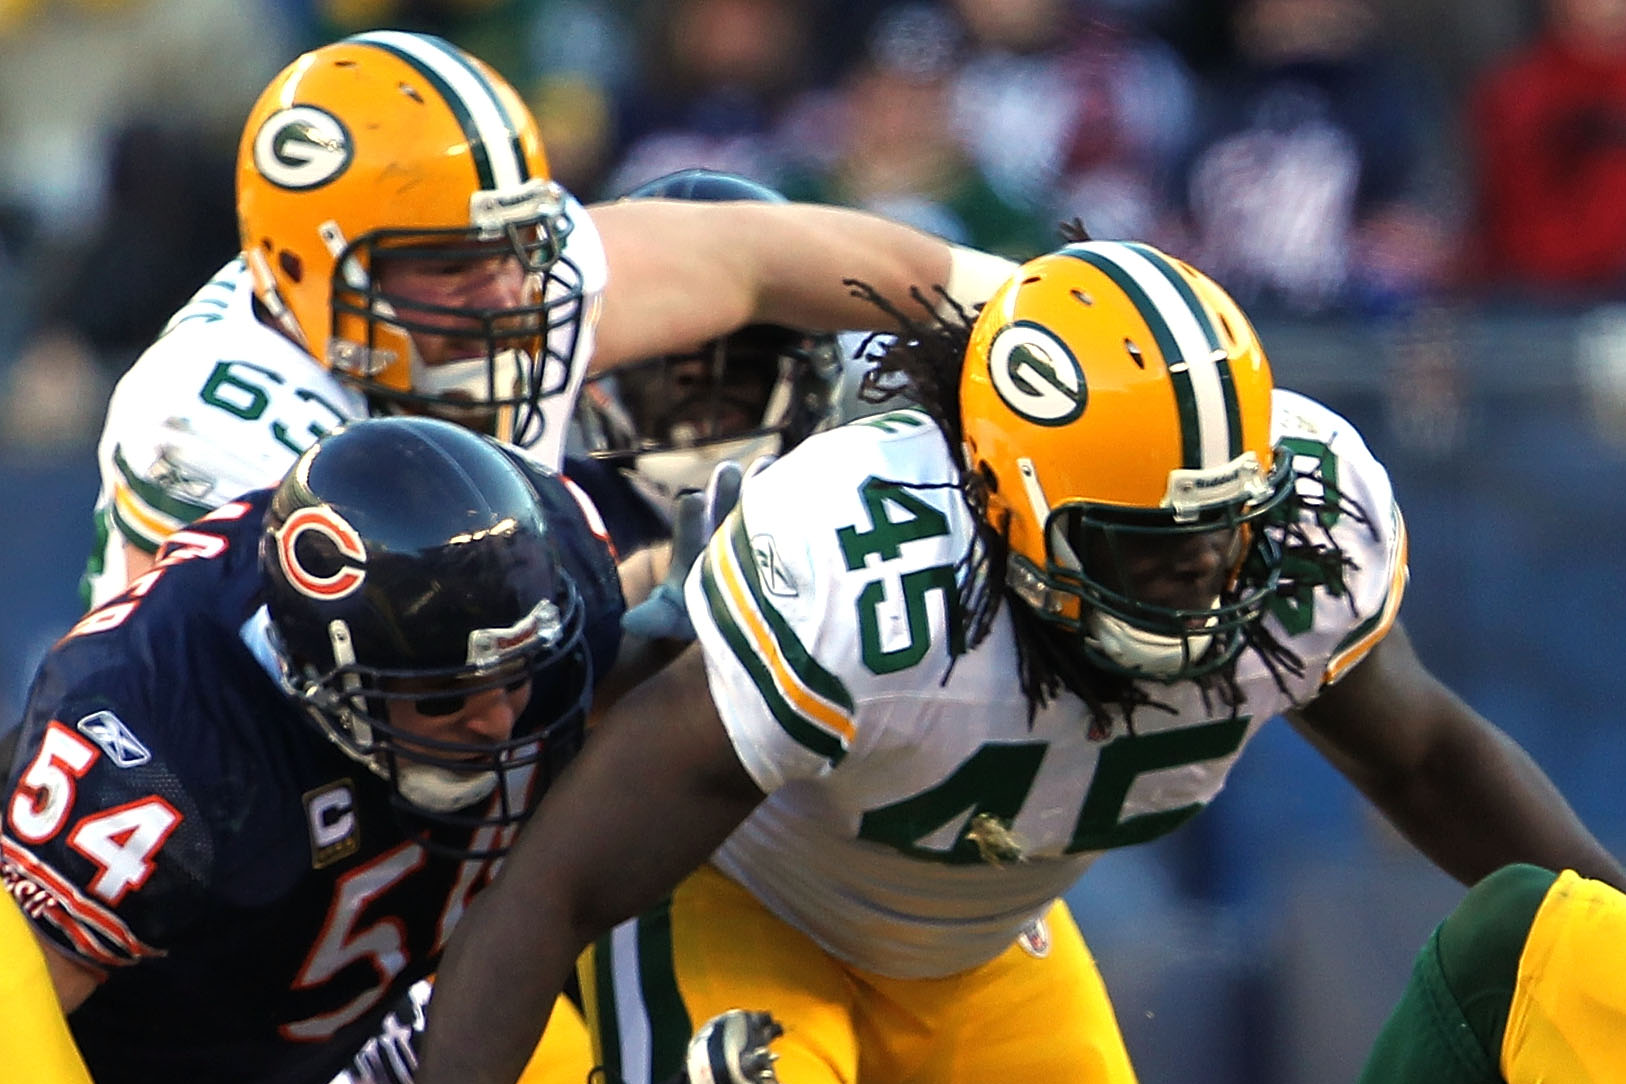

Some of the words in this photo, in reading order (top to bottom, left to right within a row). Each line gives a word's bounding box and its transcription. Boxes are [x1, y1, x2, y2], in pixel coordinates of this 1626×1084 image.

[836, 474, 968, 677] 45
[6, 718, 184, 908] 54
[309, 786, 356, 850] C
[857, 714, 1254, 866] 45
